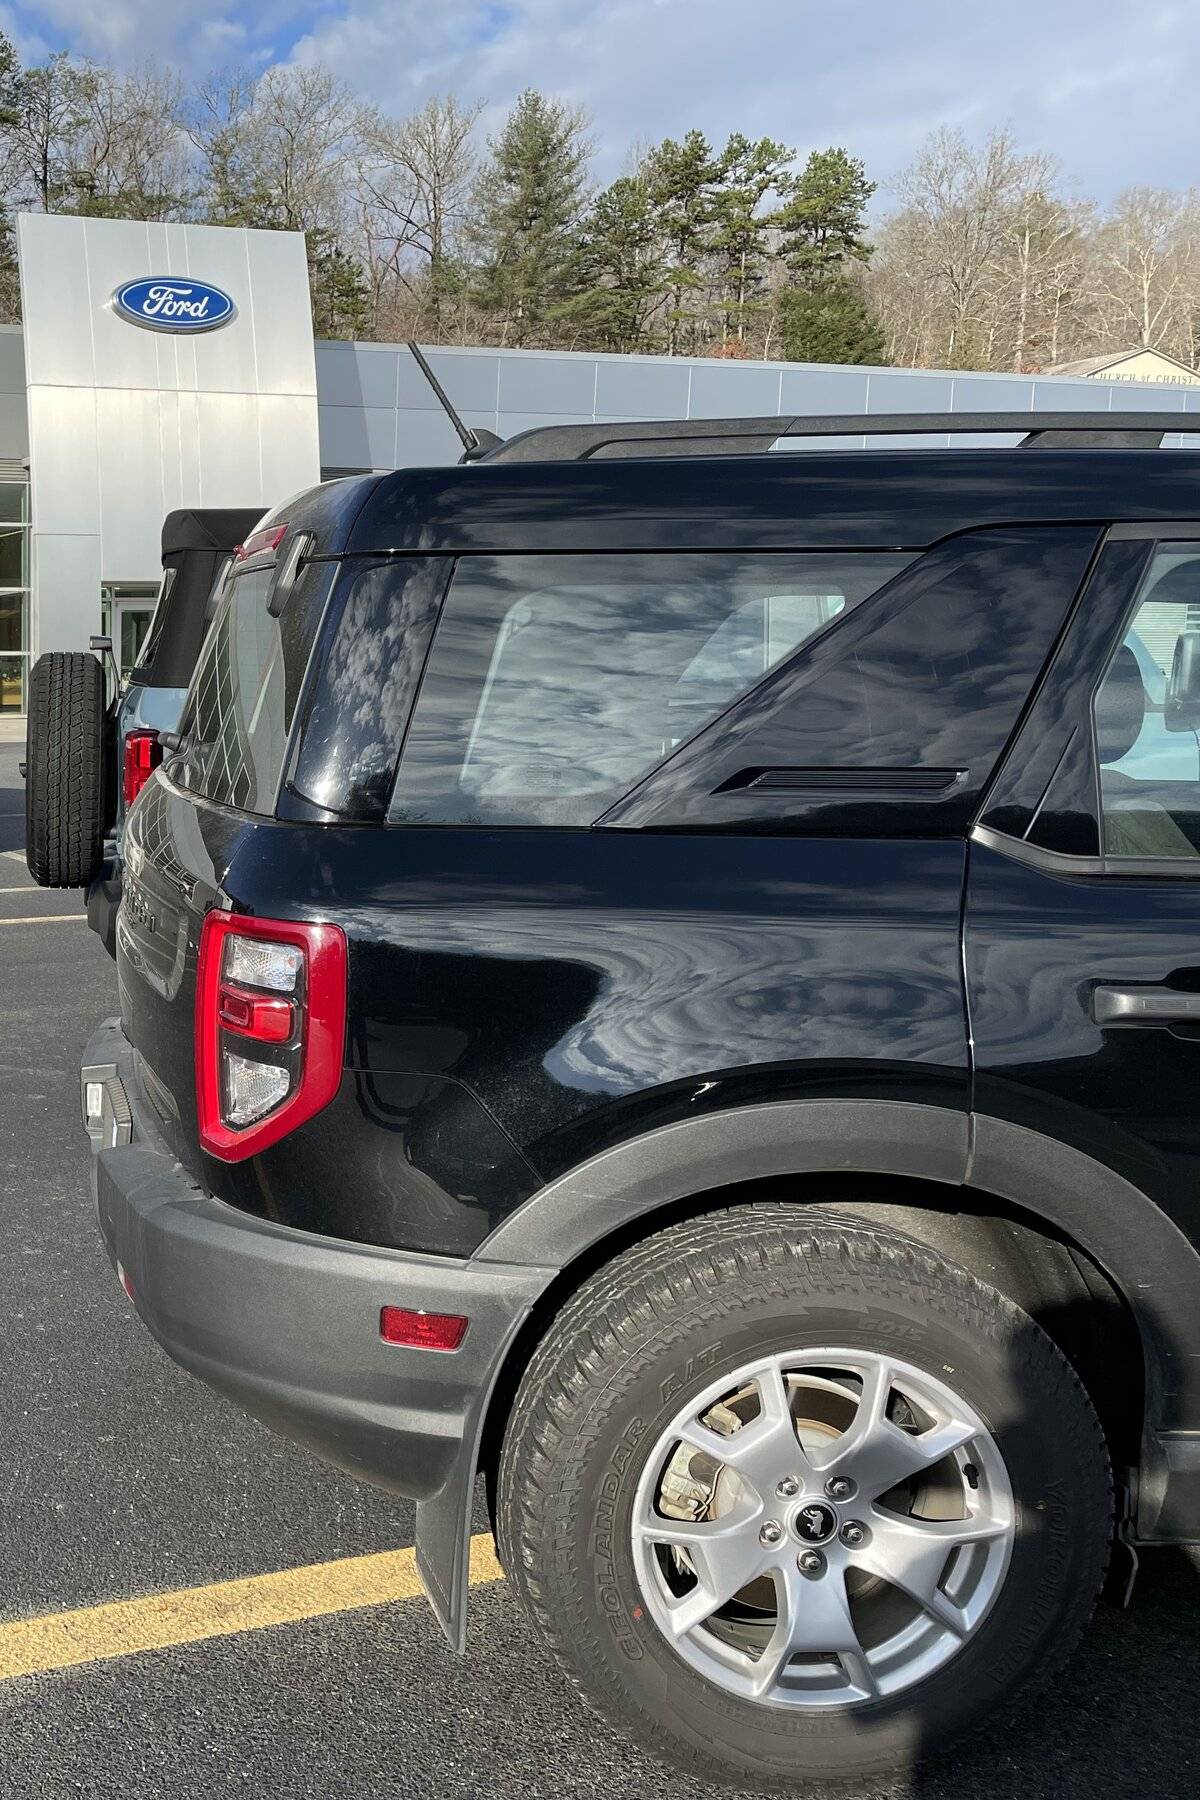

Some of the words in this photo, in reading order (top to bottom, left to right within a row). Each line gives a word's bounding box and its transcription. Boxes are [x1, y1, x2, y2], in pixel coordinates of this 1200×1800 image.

[142, 286, 209, 318] Ford
[1156, 375, 1194, 385] CHRIST
[596, 1416, 647, 1660] GEOLANDAR
[659, 1341, 723, 1403] A/T
